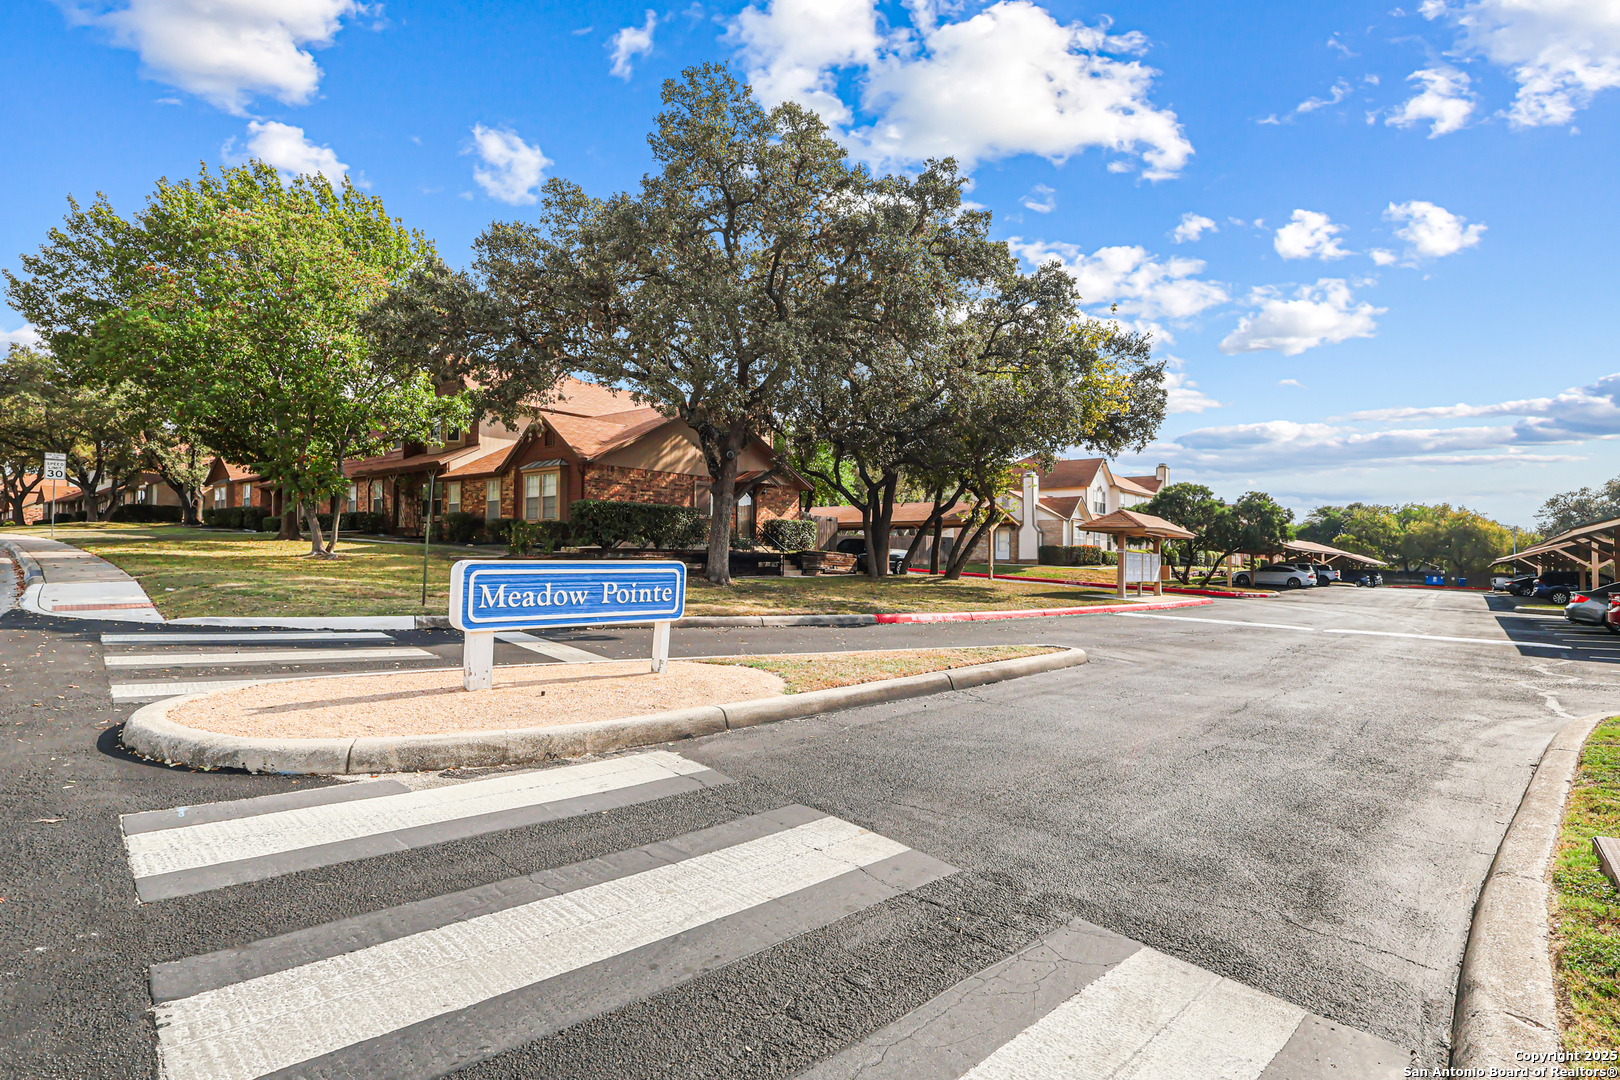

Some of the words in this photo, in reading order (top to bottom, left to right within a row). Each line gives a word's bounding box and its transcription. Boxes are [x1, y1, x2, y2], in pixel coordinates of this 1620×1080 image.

[47, 469, 63, 478] 30
[479, 582, 589, 609] Meadow
[601, 581, 673, 604] Pointe
